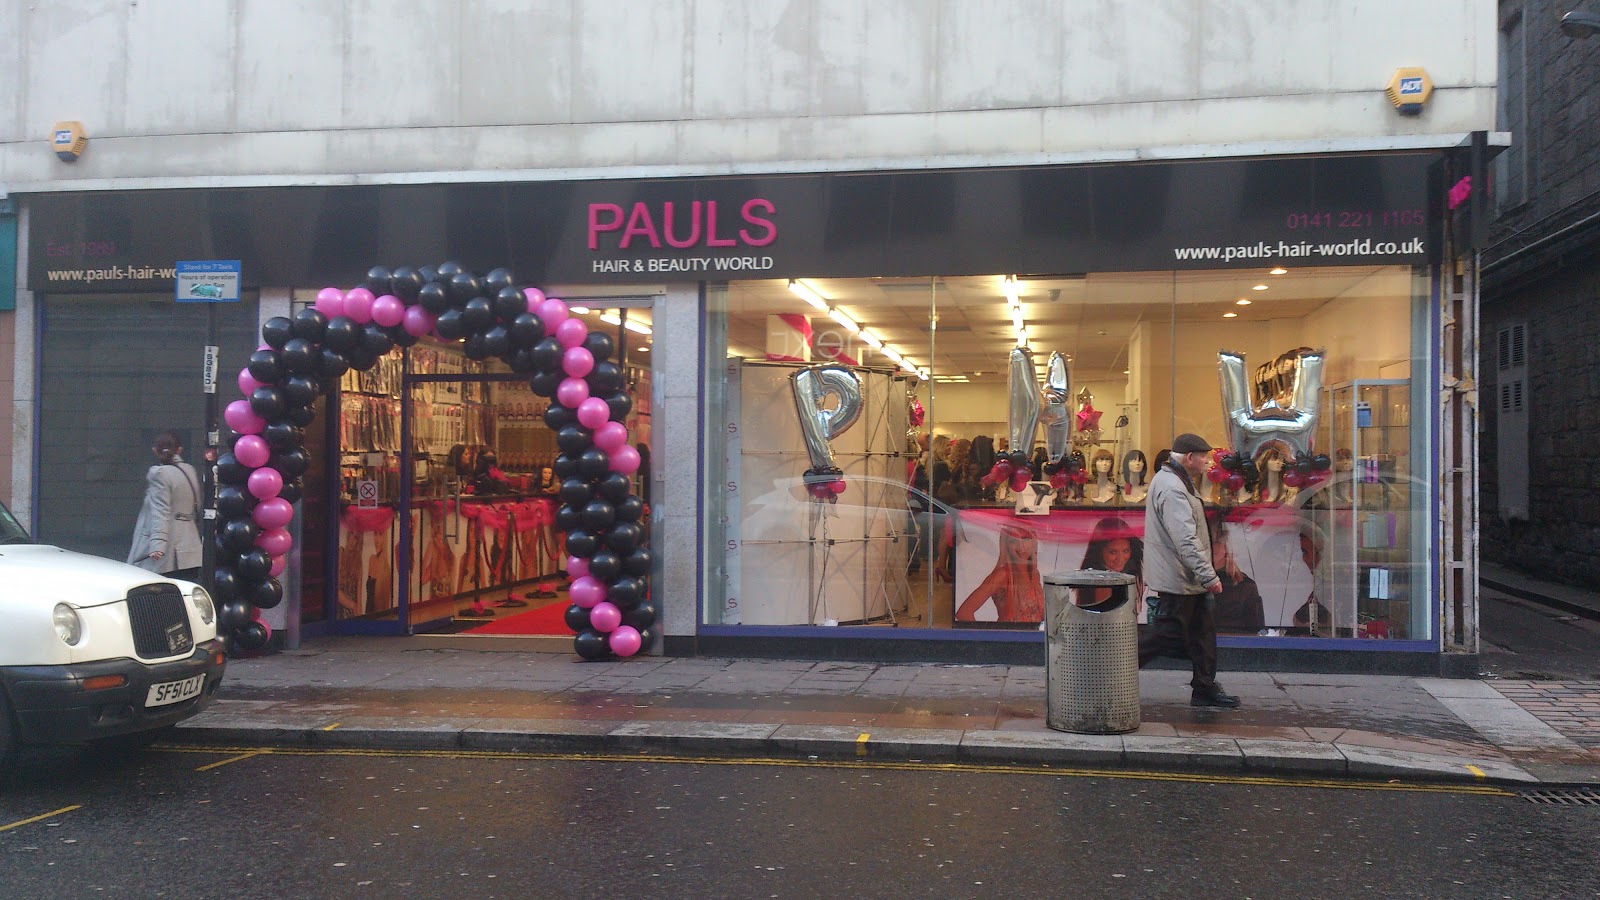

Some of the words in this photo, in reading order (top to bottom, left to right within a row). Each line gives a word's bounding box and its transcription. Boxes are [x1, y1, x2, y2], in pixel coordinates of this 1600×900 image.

[587, 198, 778, 249] PAULS
[592, 259, 629, 273] HAIR
[633, 259, 645, 272] &
[648, 258, 711, 272] BEAUTY
[714, 257, 774, 271] WORLD
[1174, 237, 1424, 262] www.pauls-hair-world.co.uk
[789, 361, 865, 468] P
